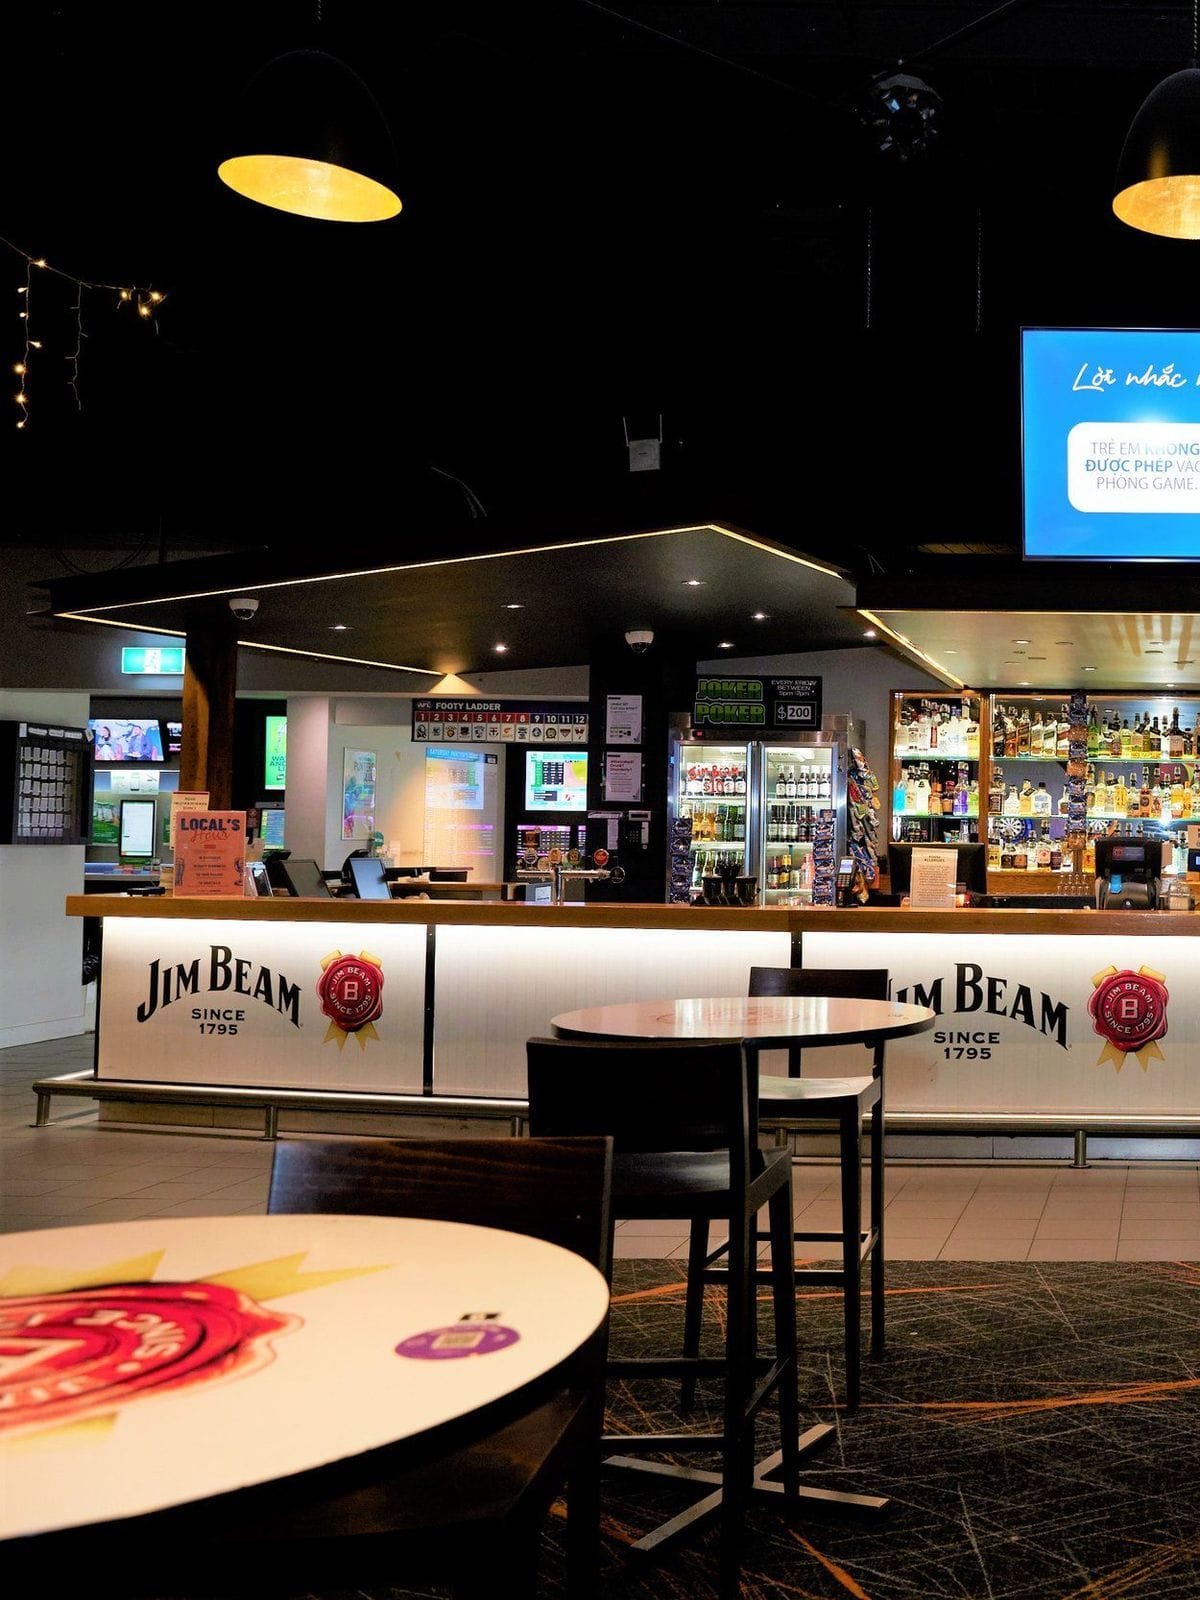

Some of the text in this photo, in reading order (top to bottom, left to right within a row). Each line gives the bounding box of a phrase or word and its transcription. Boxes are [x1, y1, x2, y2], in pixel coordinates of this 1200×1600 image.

[1125, 363, 1187, 388] nhắc
[1120, 442, 1140, 456] EM
[1152, 477, 1198, 490] GAME.
[697, 680, 763, 701] JOKER
[436, 702, 464, 710] FOOTY
[466, 702, 500, 711] LADDER
[695, 702, 765, 724] POKER
[181, 818, 241, 831] LOCAL'S
[136, 944, 304, 1029] JIM BEAM
[952, 962, 1071, 1051] BEAM
[191, 1007, 246, 1021] SINCE
[198, 1023, 238, 1036] 1795
[933, 1031, 1001, 1044] SINCE
[943, 1047, 993, 1060] 1795
